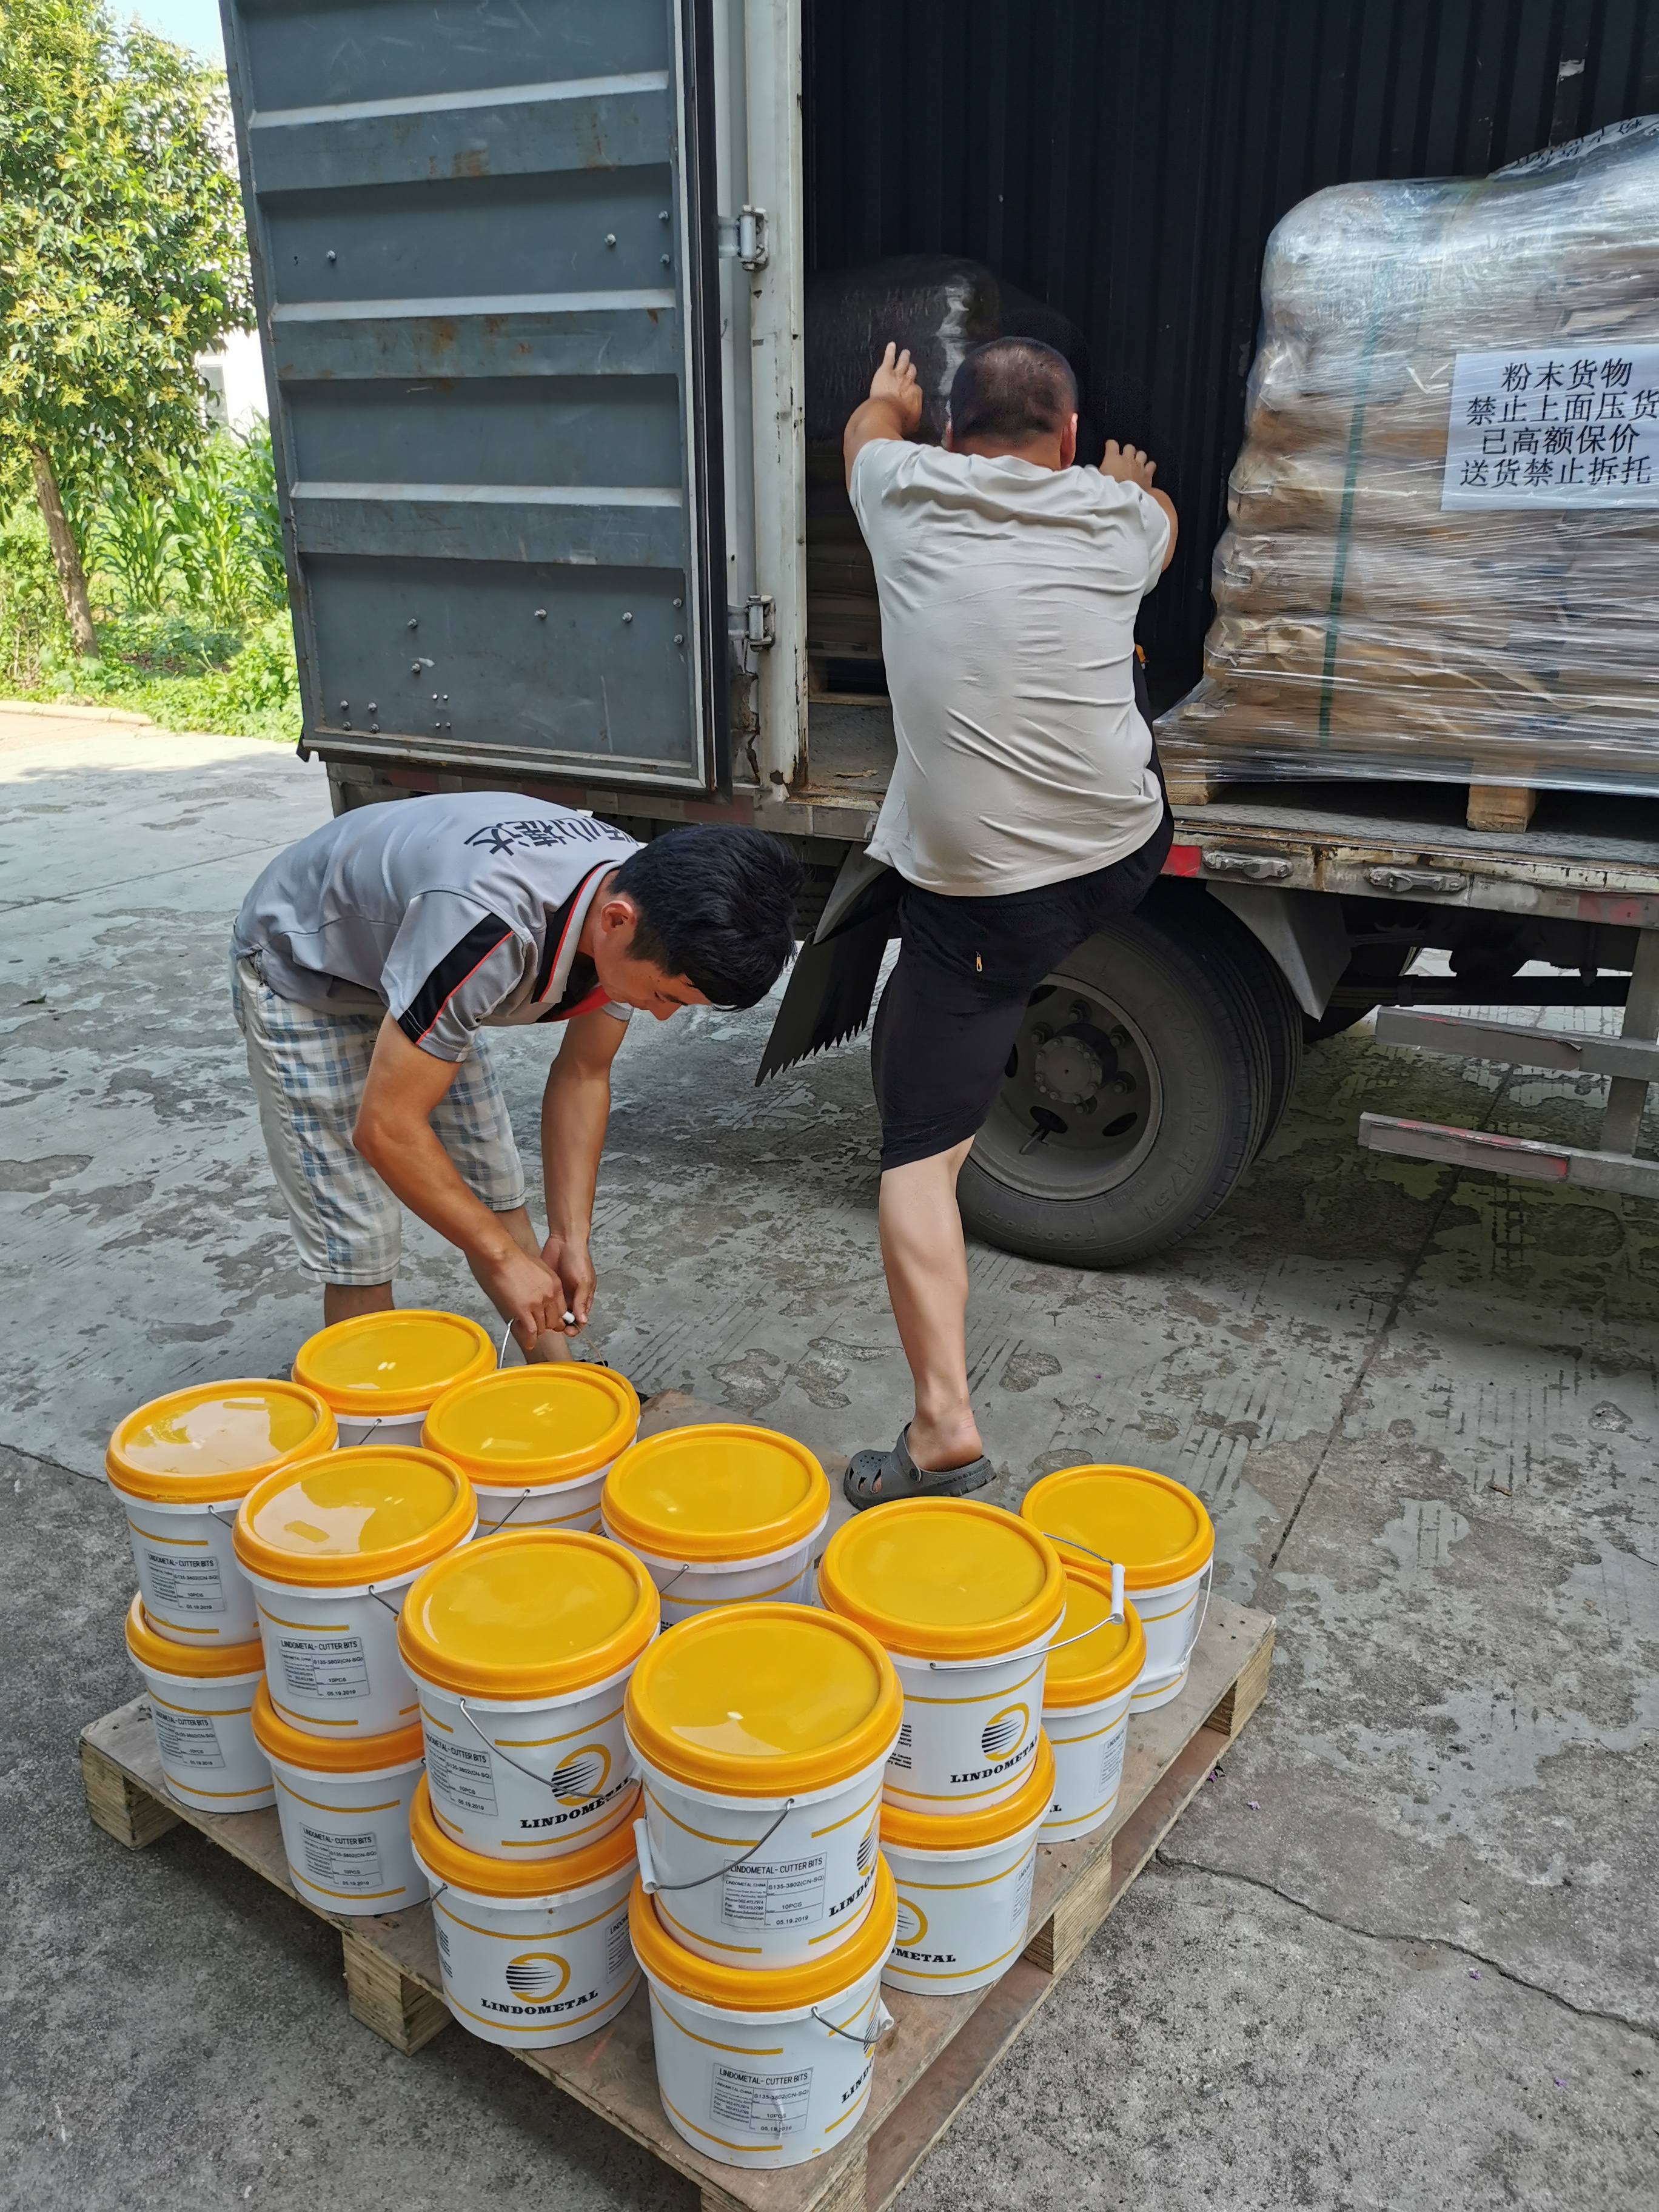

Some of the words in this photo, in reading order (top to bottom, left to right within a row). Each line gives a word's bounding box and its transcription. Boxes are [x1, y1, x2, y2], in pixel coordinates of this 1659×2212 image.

[1501, 357, 1632, 392] 粉末货物
[1466, 389, 1659, 426] 禁止上面压货
[1482, 423, 1641, 456] 已高额保价
[1460, 455, 1652, 489] 送货禁止拆托
[343, 1641, 358, 1649] BITS
[451, 1747, 472, 1761] CUTTER
[474, 1754, 487, 1763] BITS
[459, 1786, 476, 1795] 10PCS
[780, 1862, 806, 1873] CUTTER
[808, 1857, 823, 1868] BITS
[768, 1875, 824, 1889] S135-3802(CN-SQ)
[776, 1915, 809, 1925] 05.19.2019
[891, 1948, 956, 1963] METAL
[481, 1989, 598, 2015] LINDOMETAL
[765, 2076, 793, 2085] CUTTER
[794, 2073, 808, 2082] BITS
[754, 2089, 809, 2100] S135-3802(CN-SQ)
